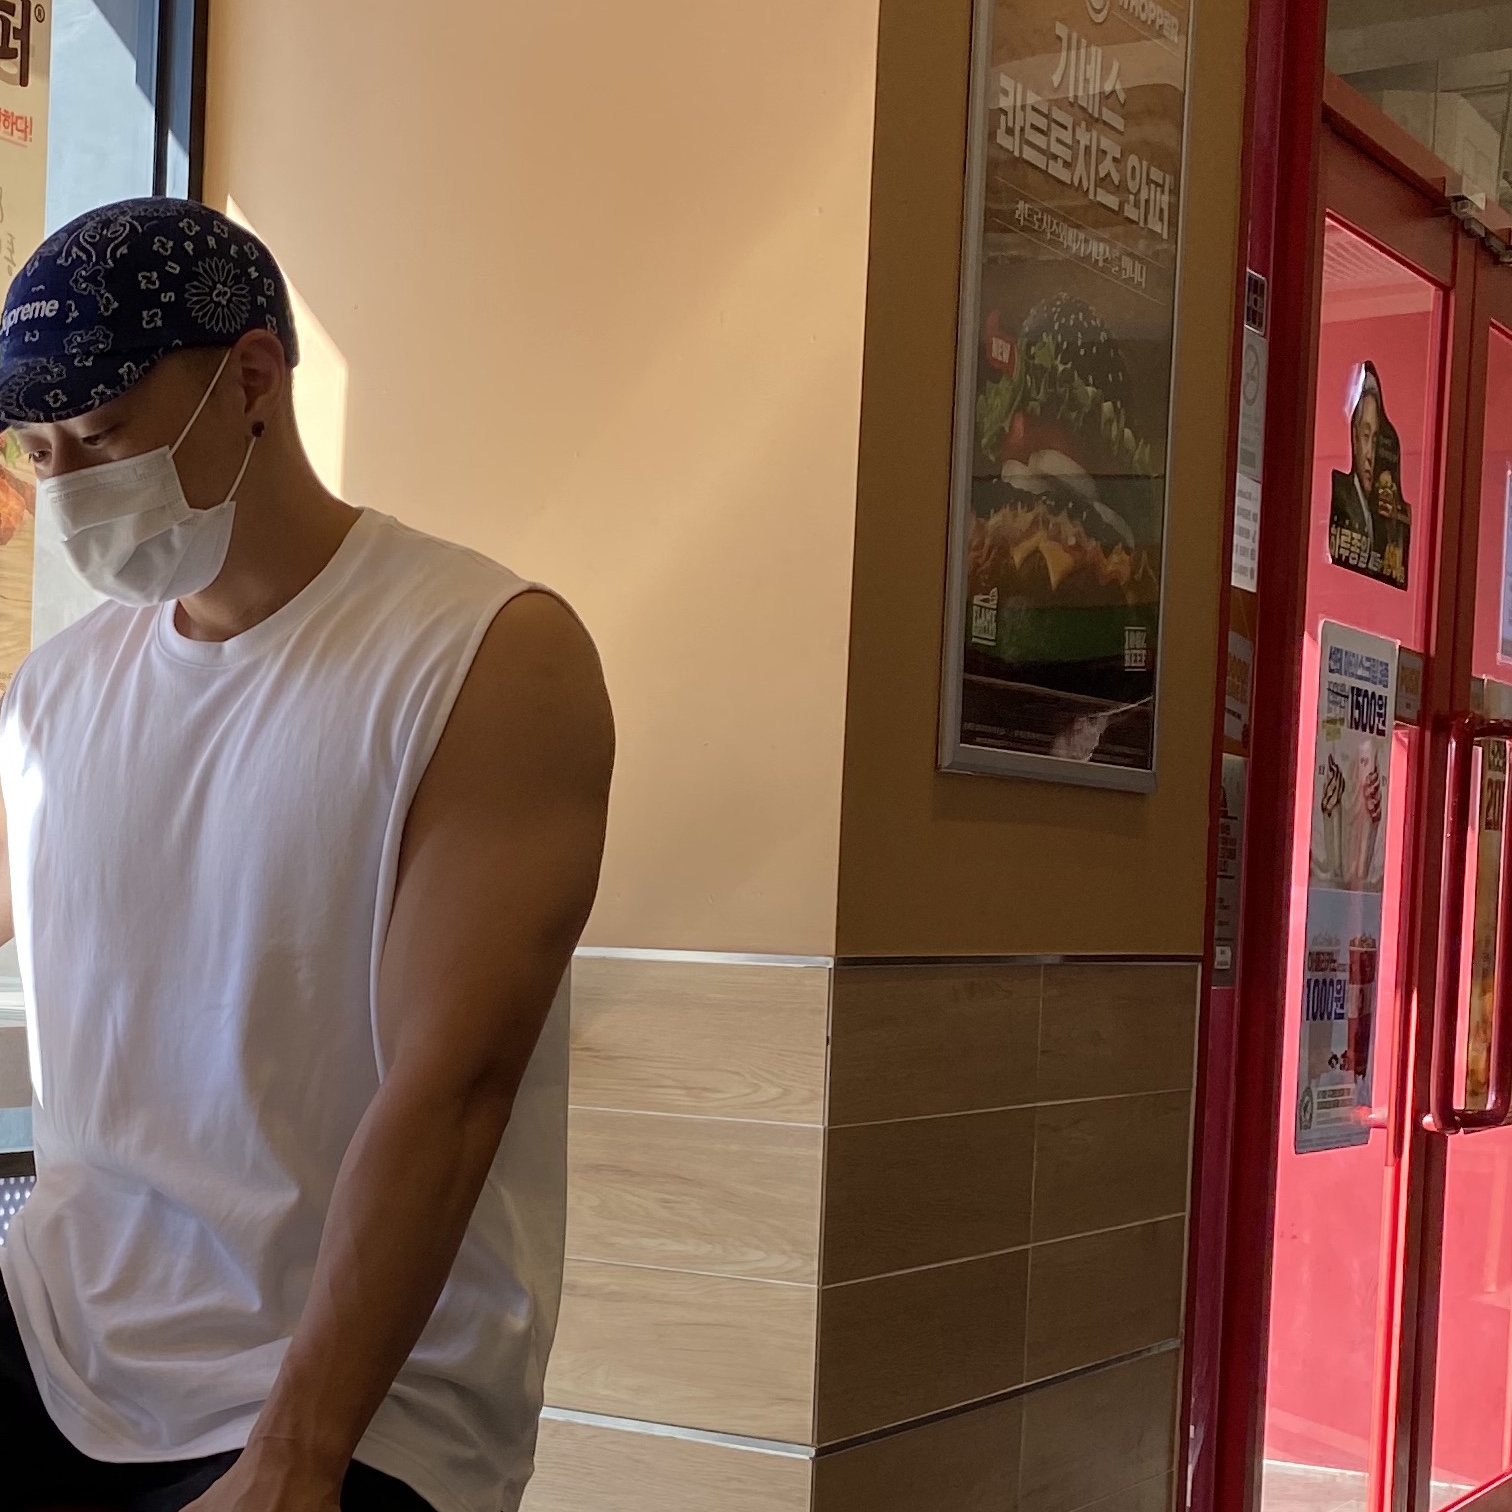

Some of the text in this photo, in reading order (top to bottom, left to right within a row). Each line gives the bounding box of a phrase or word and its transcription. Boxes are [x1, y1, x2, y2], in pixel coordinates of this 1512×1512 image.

[1051, 21, 1126, 135] 기네스
[1350, 686, 1388, 738] 1500원
[1305, 978, 1346, 1021] 1000원
